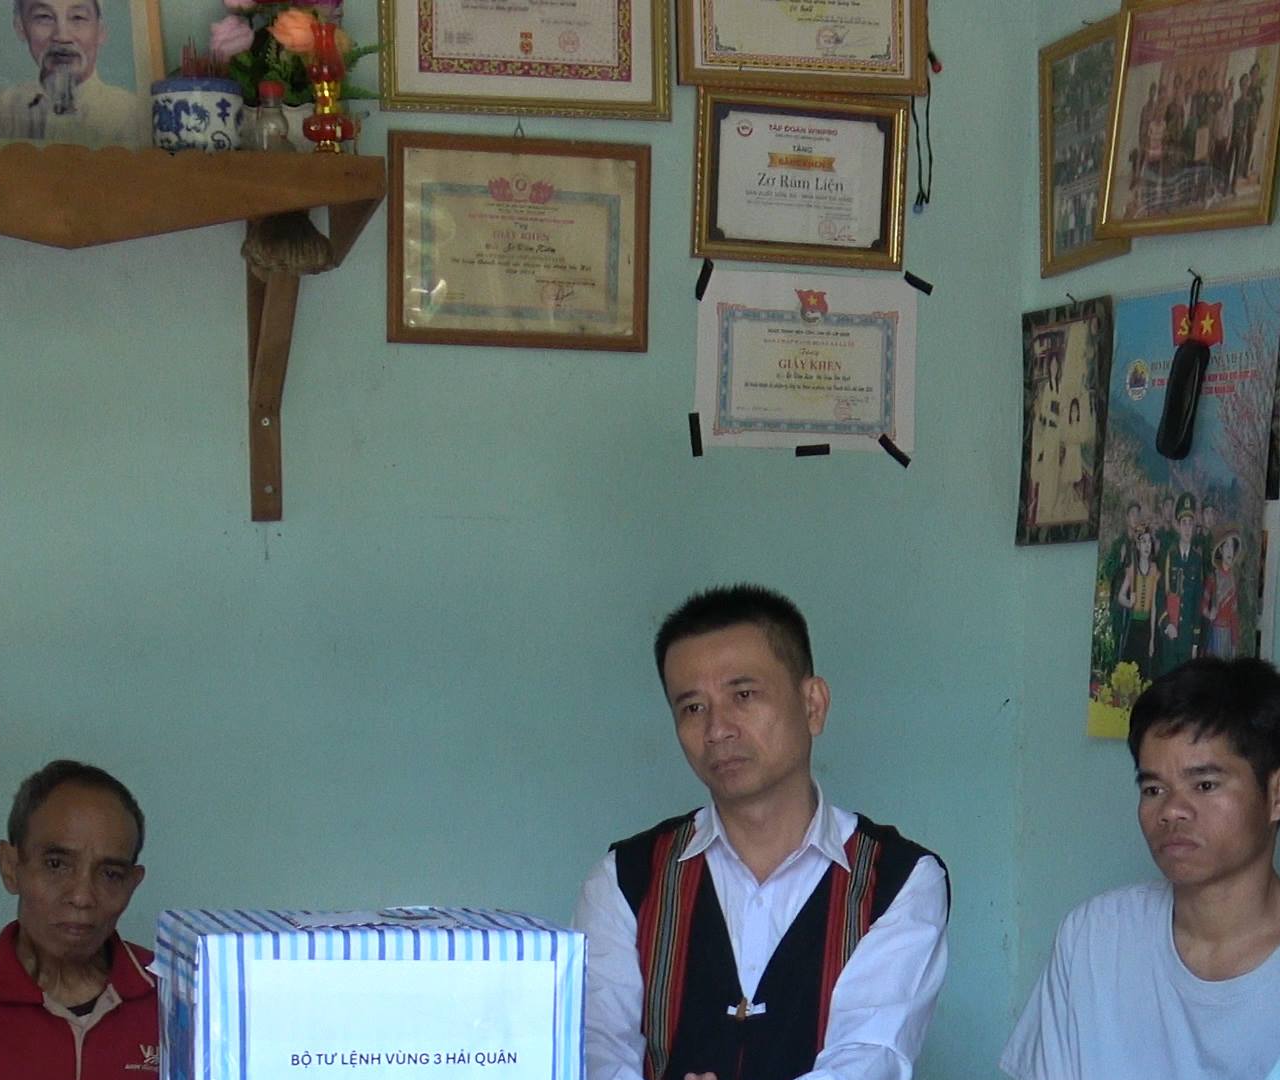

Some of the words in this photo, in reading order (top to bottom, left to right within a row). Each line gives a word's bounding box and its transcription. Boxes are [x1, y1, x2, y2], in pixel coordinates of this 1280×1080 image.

[810, 360, 842, 371] KHEN
[291, 1050, 312, 1069] BỘ
[316, 1052, 338, 1066] TƯ
[341, 1050, 381, 1068] LỆNH
[385, 1049, 430, 1065] VÙNG
[433, 1053, 442, 1065] 3
[446, 1048, 471, 1065] HẢI
[475, 1049, 517, 1067] QUÂN
